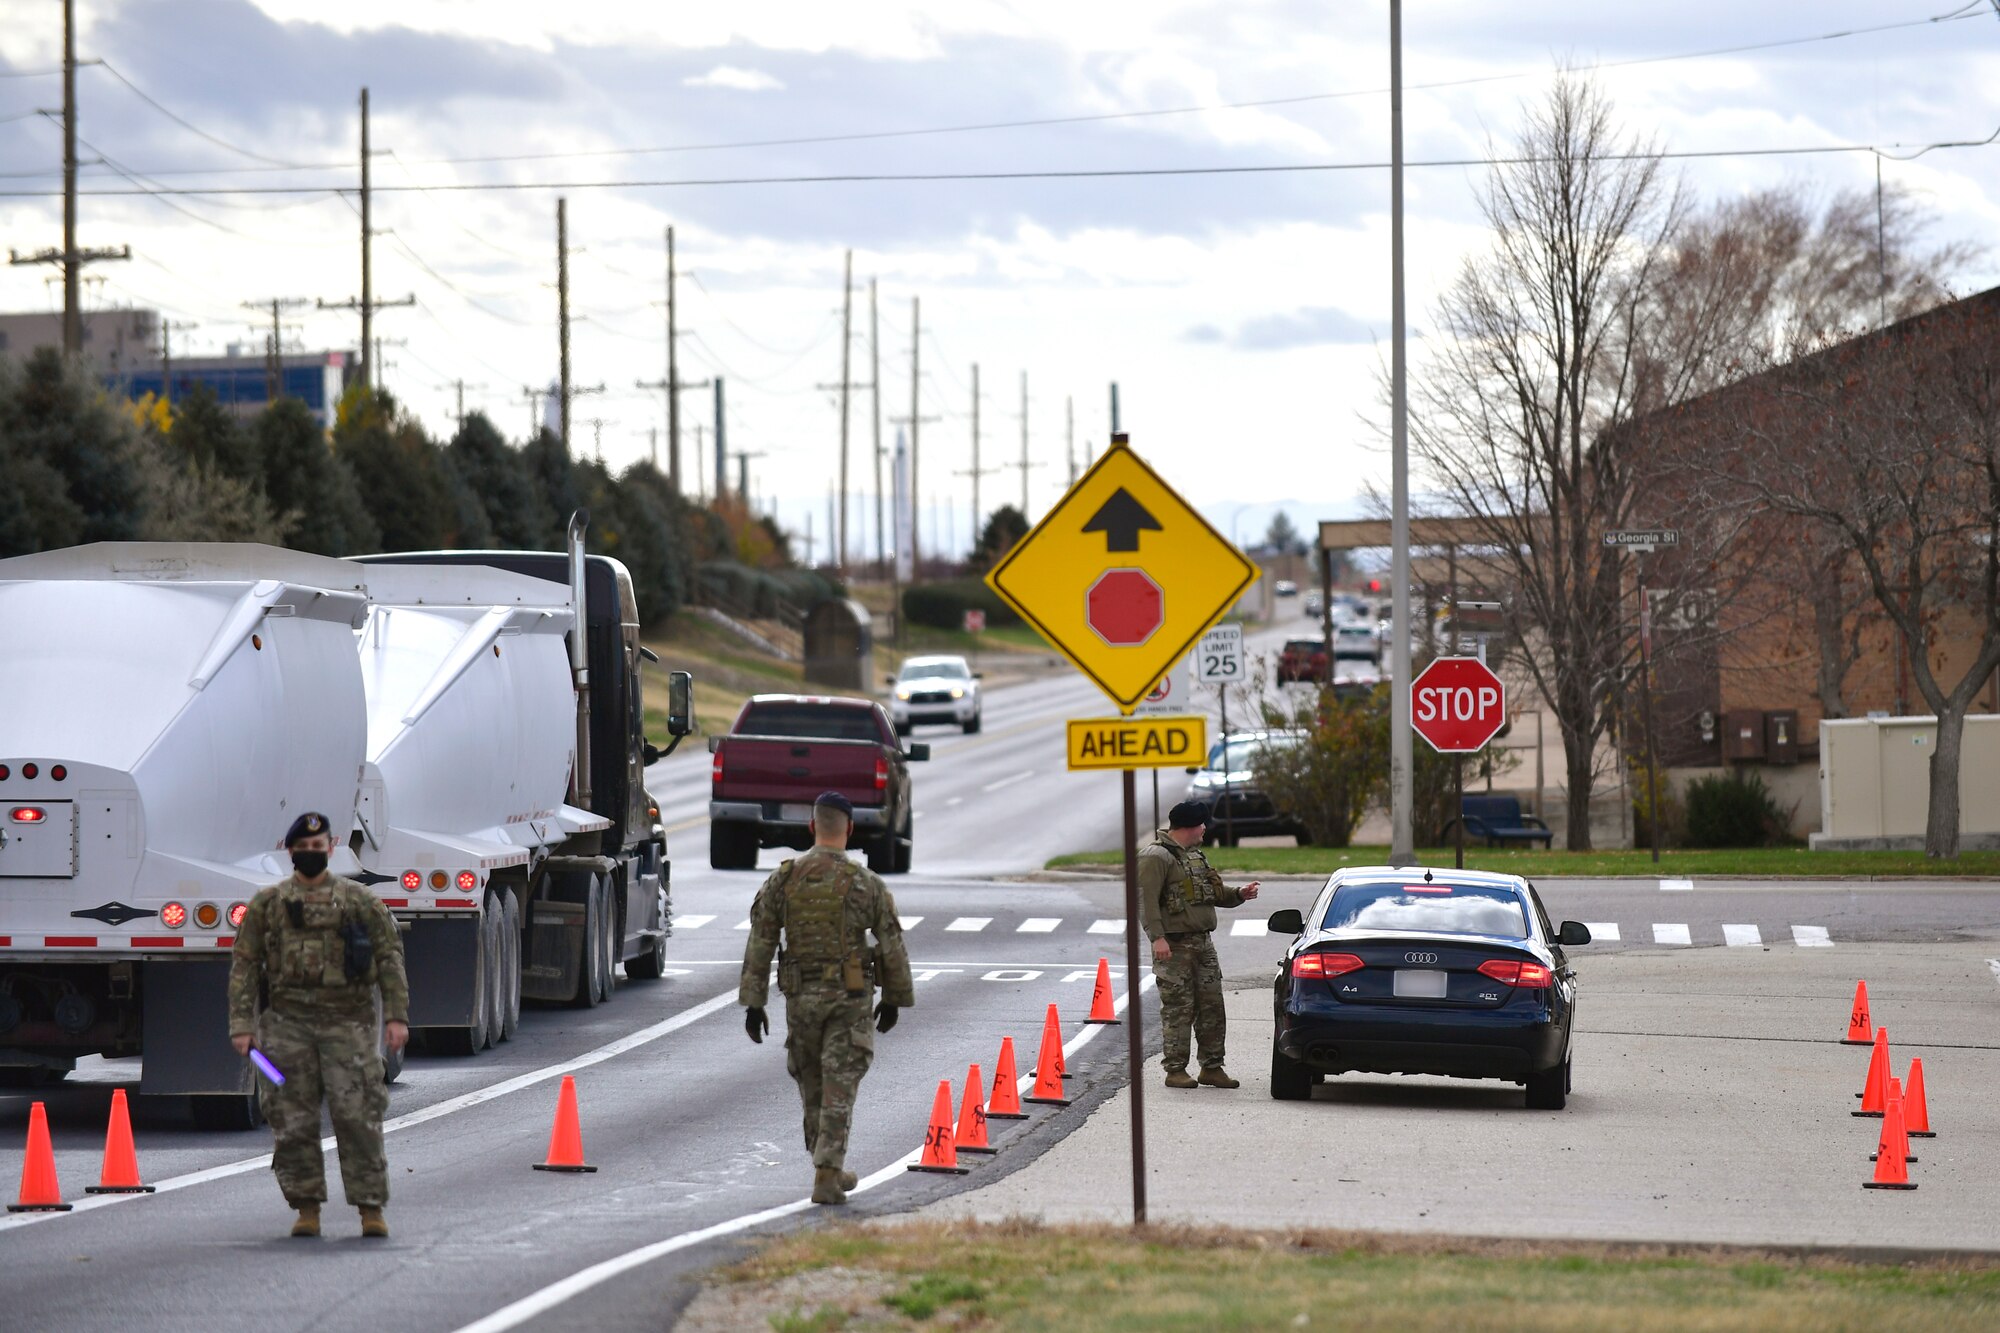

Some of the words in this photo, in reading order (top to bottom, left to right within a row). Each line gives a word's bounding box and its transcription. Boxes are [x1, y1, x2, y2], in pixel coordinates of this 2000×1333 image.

[1618, 532, 1659, 544] Georgia
[1663, 532, 1675, 543] St
[1205, 643, 1233, 652] LIMIT
[1206, 655, 1237, 676] 25
[1417, 687, 1498, 721] STOP
[1081, 728, 1189, 757] AHEAD
[911, 969, 1124, 982] TOP
[1851, 1012, 1870, 1028] SF
[993, 1073, 1007, 1091] F
[974, 1104, 986, 1124] S
[925, 1125, 951, 1147] SF
